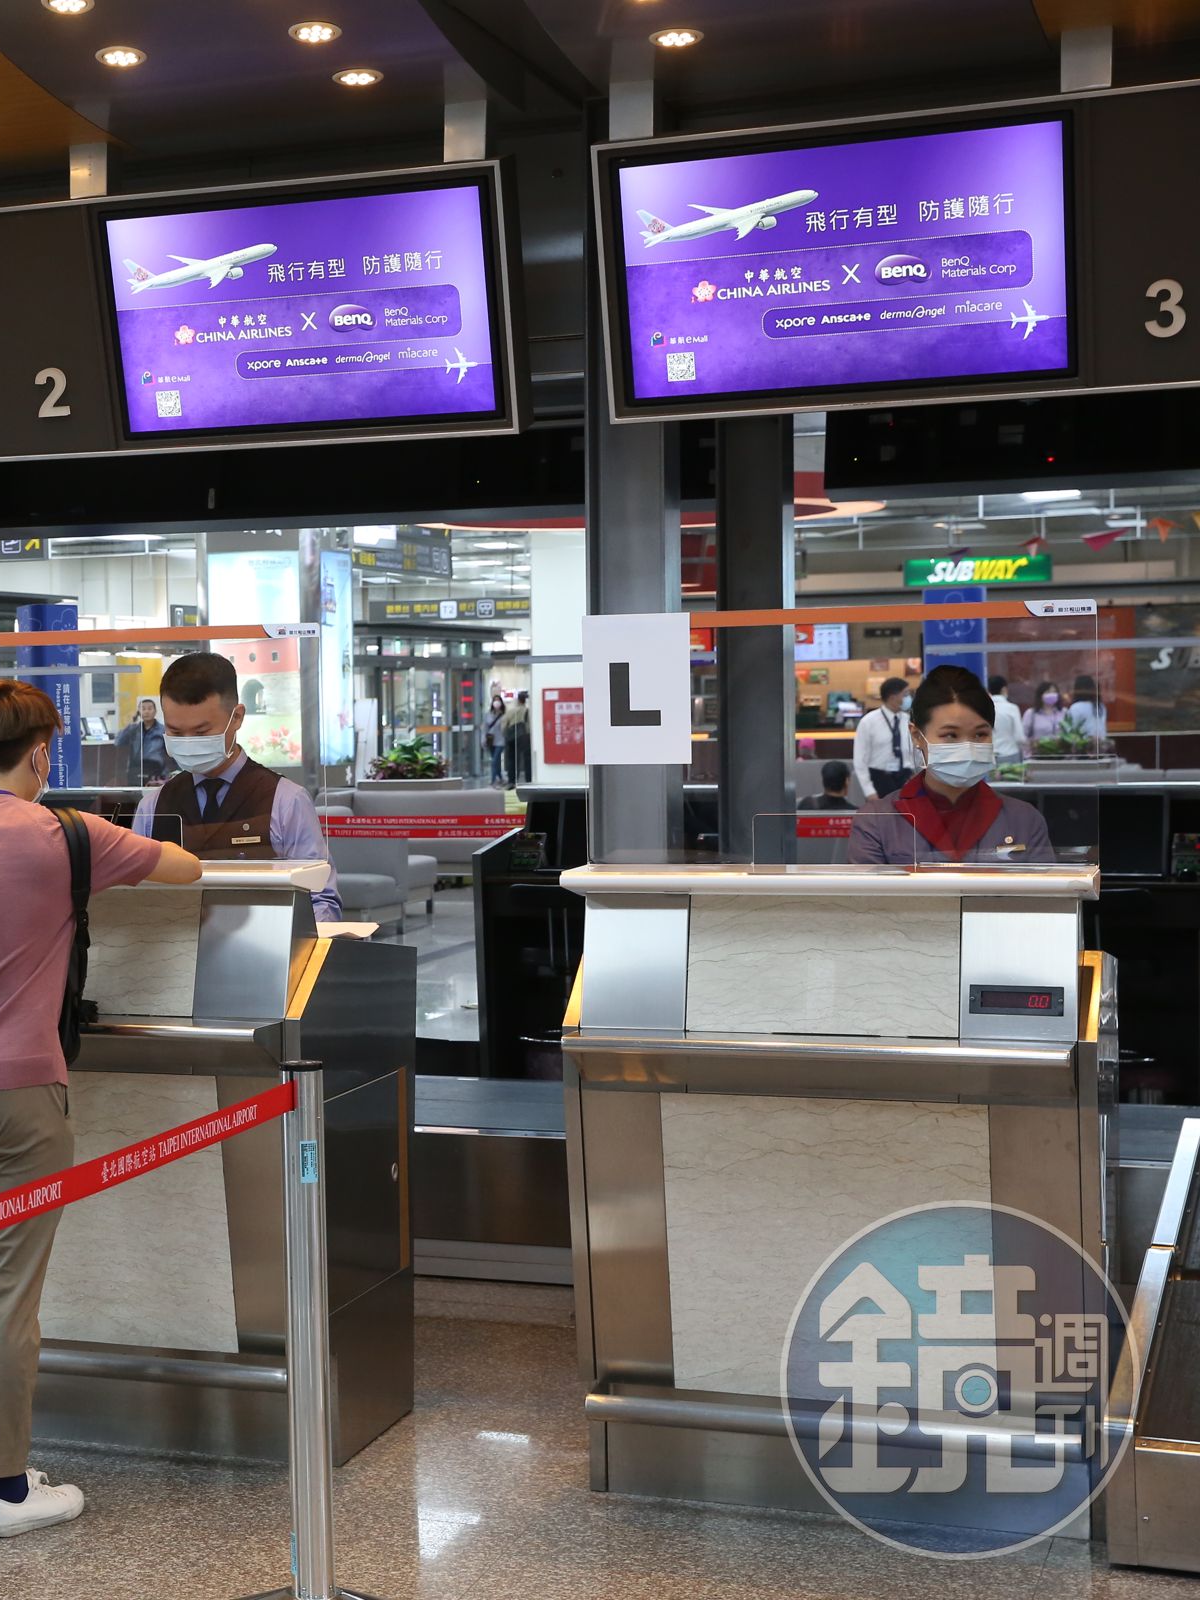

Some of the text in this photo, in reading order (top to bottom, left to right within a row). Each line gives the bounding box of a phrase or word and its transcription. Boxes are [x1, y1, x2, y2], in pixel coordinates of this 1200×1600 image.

[805, 192, 1014, 234] 飛行有型 防護隨行
[941, 255, 970, 267] BenQ
[267, 258, 346, 284] 飛行有型
[744, 266, 802, 283] 中華航空
[881, 264, 927, 280] BenQ
[941, 264, 1017, 279] Materials Corp
[717, 279, 831, 301] CHINA AIRLINES
[384, 306, 409, 317] BenQ
[1144, 278, 1187, 338] 3
[334, 312, 373, 327] BenQ
[385, 314, 448, 327] Materials Corp
[775, 315, 816, 330] xpore
[196, 326, 293, 344] CHINA AIRLINES
[247, 357, 282, 371] xpore
[34, 367, 71, 418] 2
[927, 557, 1028, 584] SUBWAY
[608, 662, 662, 727] L
[158, 1134, 182, 1159] TAIPEI
[180, 1114, 232, 1150] INTERNATIONAL
[231, 1104, 259, 1130] AIRPORT
[26, 1180, 63, 1212] AIRPORT
